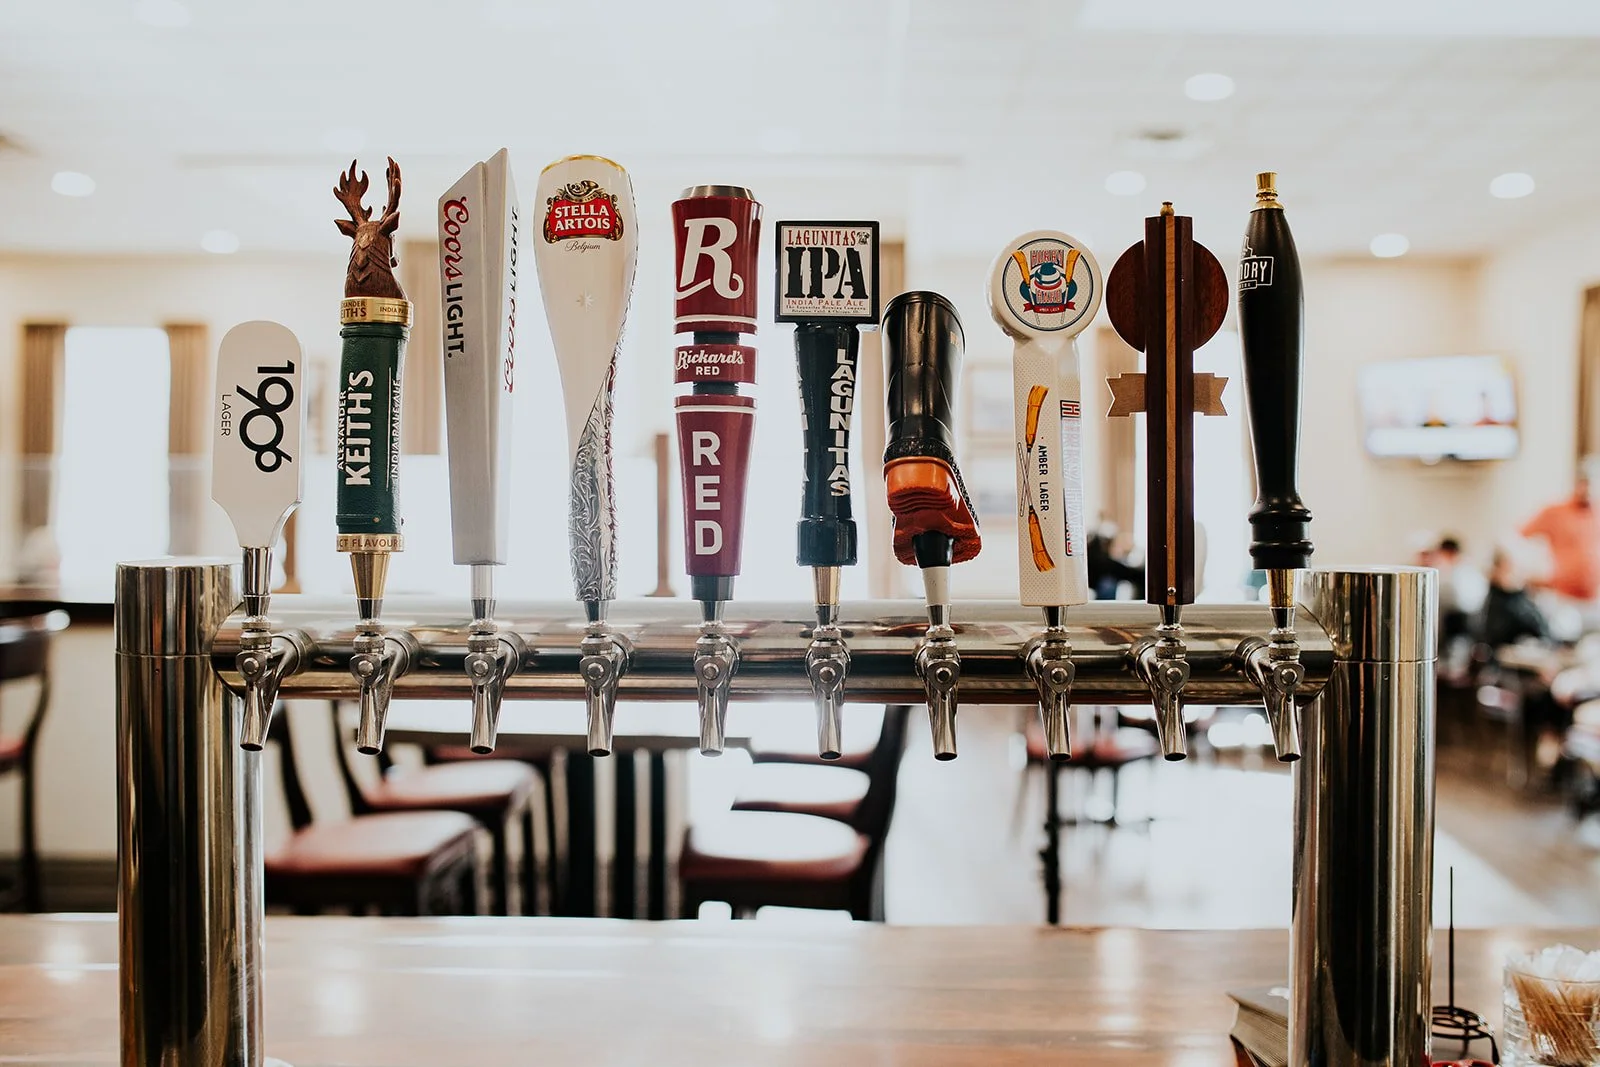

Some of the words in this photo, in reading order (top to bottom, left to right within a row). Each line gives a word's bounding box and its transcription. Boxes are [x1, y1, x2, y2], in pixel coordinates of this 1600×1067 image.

[555, 205, 609, 219] STELLA
[555, 218, 611, 231] ARTOIS
[443, 196, 469, 281] Coors
[565, 240, 600, 253] Belgium
[788, 230, 856, 246] LAGUNITAS
[675, 217, 745, 300] R
[784, 247, 869, 299] IPA
[676, 350, 744, 370] Rickard's
[695, 366, 720, 376] RED
[221, 394, 231, 437] LAGER
[236, 359, 295, 473] 1906
[337, 390, 346, 470] ALEXANDER
[345, 370, 374, 485] KEITH'S
[827, 349, 855, 497] LAGUNITAS
[1038, 445, 1048, 476] AMBER
[692, 431, 723, 555] RED
[1039, 482, 1049, 512] LAGER
[352, 539, 398, 548] FLAVOUR
